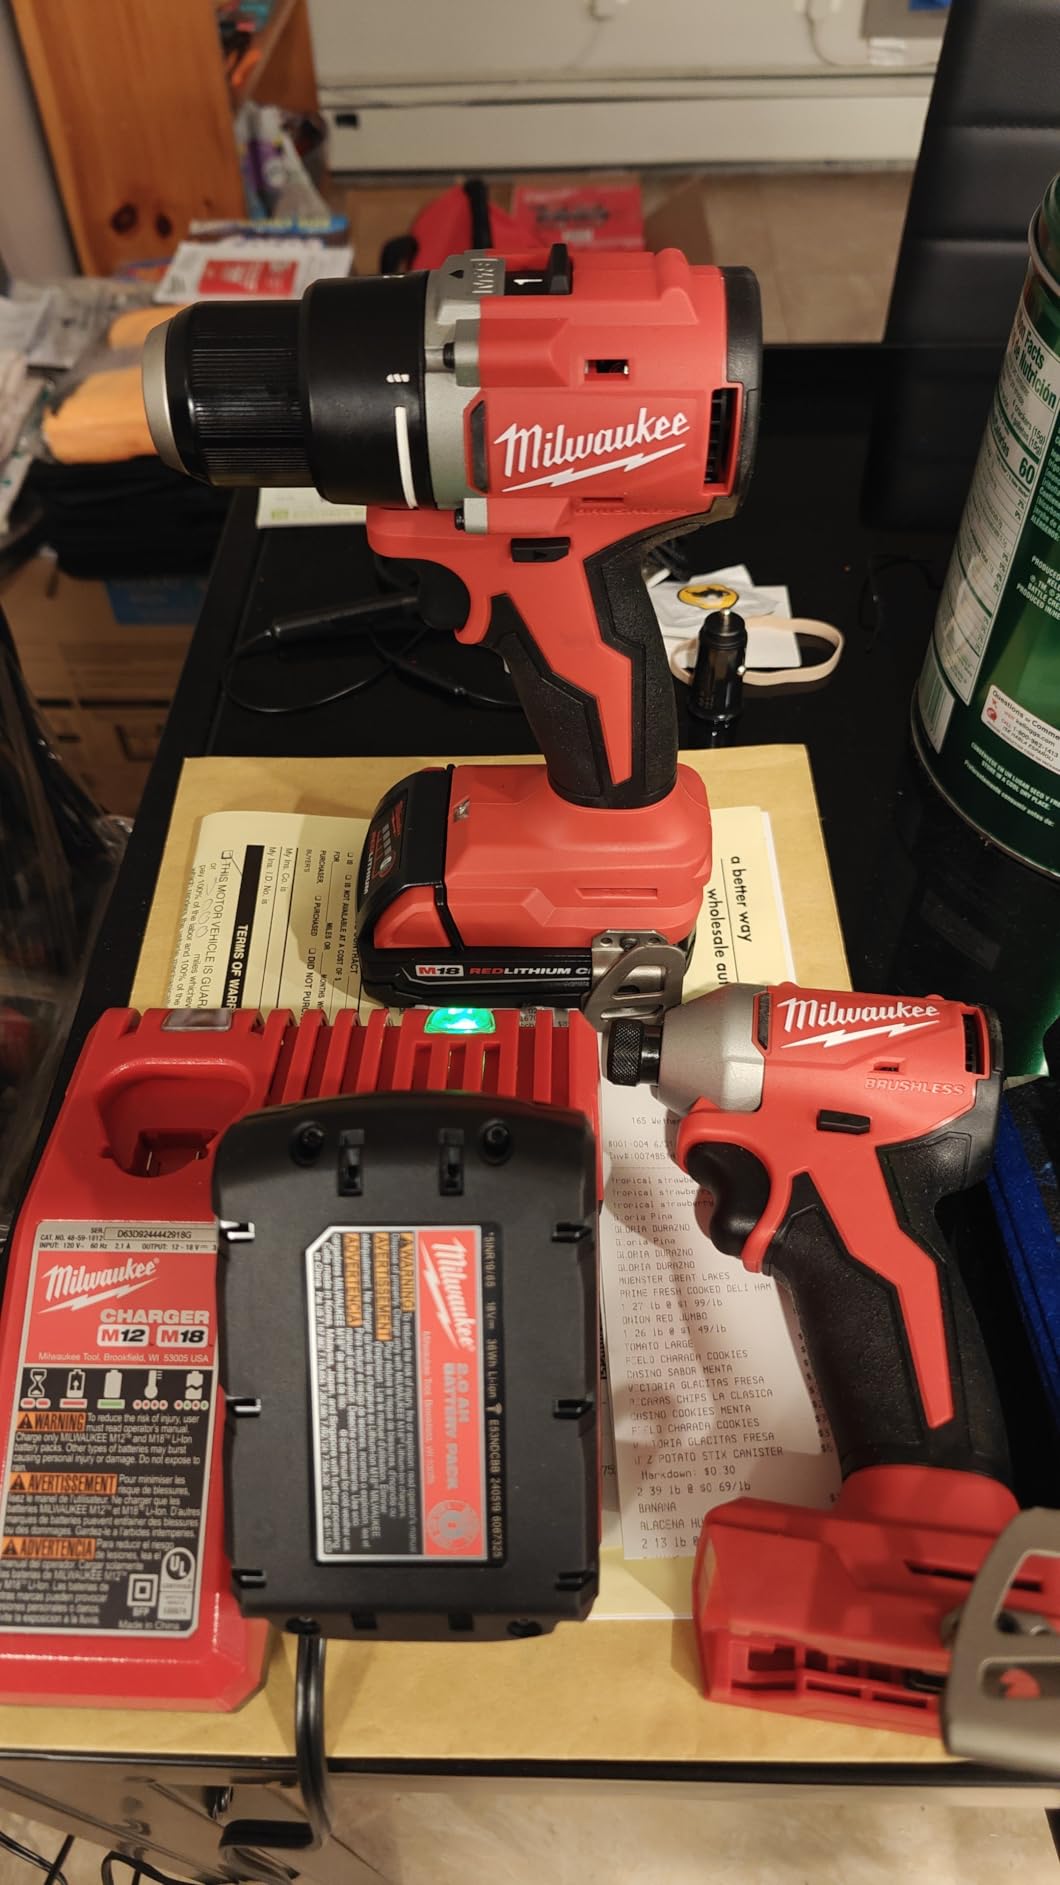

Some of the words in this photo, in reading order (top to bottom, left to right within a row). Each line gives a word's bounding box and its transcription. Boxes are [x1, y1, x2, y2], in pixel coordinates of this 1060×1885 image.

[1025, 330, 1044, 369] Facts
[494, 407, 690, 477] Milwaukee
[1019, 458, 1034, 484] 60
[266, 847, 276, 857] My
[283, 848, 293, 858] My
[265, 859, 274, 869] Ins.
[282, 859, 291, 870] Ins.
[731, 856, 740, 864] a
[218, 862, 231, 883] THIS
[281, 873, 290, 884] Co.
[732, 869, 747, 906] better
[212, 885, 227, 919] MOTOR
[343, 890, 351, 900] NOT
[311, 902, 321, 936] PURCHASED
[339, 903, 350, 932] AVAILABLE
[708, 888, 728, 958] wholesale
[325, 923, 333, 939] MILES
[737, 912, 752, 942] way
[205, 922, 220, 963] VEHICLE
[233, 924, 249, 959] TERMS
[324, 941, 330, 950] OR
[182, 943, 192, 957] and
[190, 954, 202, 974] miles
[307, 956, 316, 969] DID
[336, 950, 345, 965] COST
[204, 966, 214, 974] IS
[231, 962, 242, 976] OF
[336, 967, 342, 975] OF
[469, 967, 571, 975] REDLITHIUM
[304, 972, 314, 989] NOT
[317, 974, 327, 998] MONTHS
[777, 997, 940, 1032] Milwaukee
[864, 1078, 965, 1096] BRUSHLESS
[653, 1224, 690, 1232] DURAZNO
[656, 1248, 693, 1257] DURAZNO
[657, 1261, 695, 1270] DURAZNO
[41, 1258, 156, 1302] Milwaukee
[346, 1236, 360, 1323] ADVERTENCIA
[401, 1248, 414, 1309] WARNING
[702, 1272, 730, 1281] LAKES
[375, 1237, 391, 1337] AVERTISSEMENT
[431, 1237, 476, 1347] Milwaukee
[654, 1287, 681, 1296] FRESH
[687, 1285, 720, 1295] COOKED
[100, 1309, 210, 1324] CHARGER
[656, 1314, 673, 1323] RED
[101, 1329, 146, 1342] M12
[160, 1329, 205, 1343] M18
[665, 1340, 694, 1349] LARGE
[38, 1352, 80, 1361] Milwaukee
[164, 1354, 188, 1362] 53005
[707, 1350, 748, 1360] COOKIES
[668, 1367, 697, 1377] SABOR
[703, 1365, 733, 1374] MENTA
[734, 1375, 765, 1385] FRESA
[713, 1393, 725, 1401] LA
[731, 1389, 773, 1399] CLASICA
[672, 1407, 715, 1418] COOKIES
[721, 1404, 751, 1414] MENTA
[35, 1413, 84, 1430] WARNING
[124, 1414, 135, 1422] the
[105, 1424, 122, 1432] read
[717, 1418, 760, 1429] COOKIES
[43, 1433, 58, 1443] only
[61, 1433, 107, 1442] MILWAUKEE
[133, 1435, 147, 1443] and
[744, 1432, 775, 1442] FRESA
[659, 1452, 696, 1463] POTATO
[702, 1450, 726, 1460] STIX
[733, 1446, 783, 1458] CANISTER
[28, 1475, 115, 1492] AVERTISSEMENT
[639, 1501, 676, 1513] BANANA
[20, 1540, 93, 1558] ADVERTENCIA
[170, 1555, 186, 1576] UL
